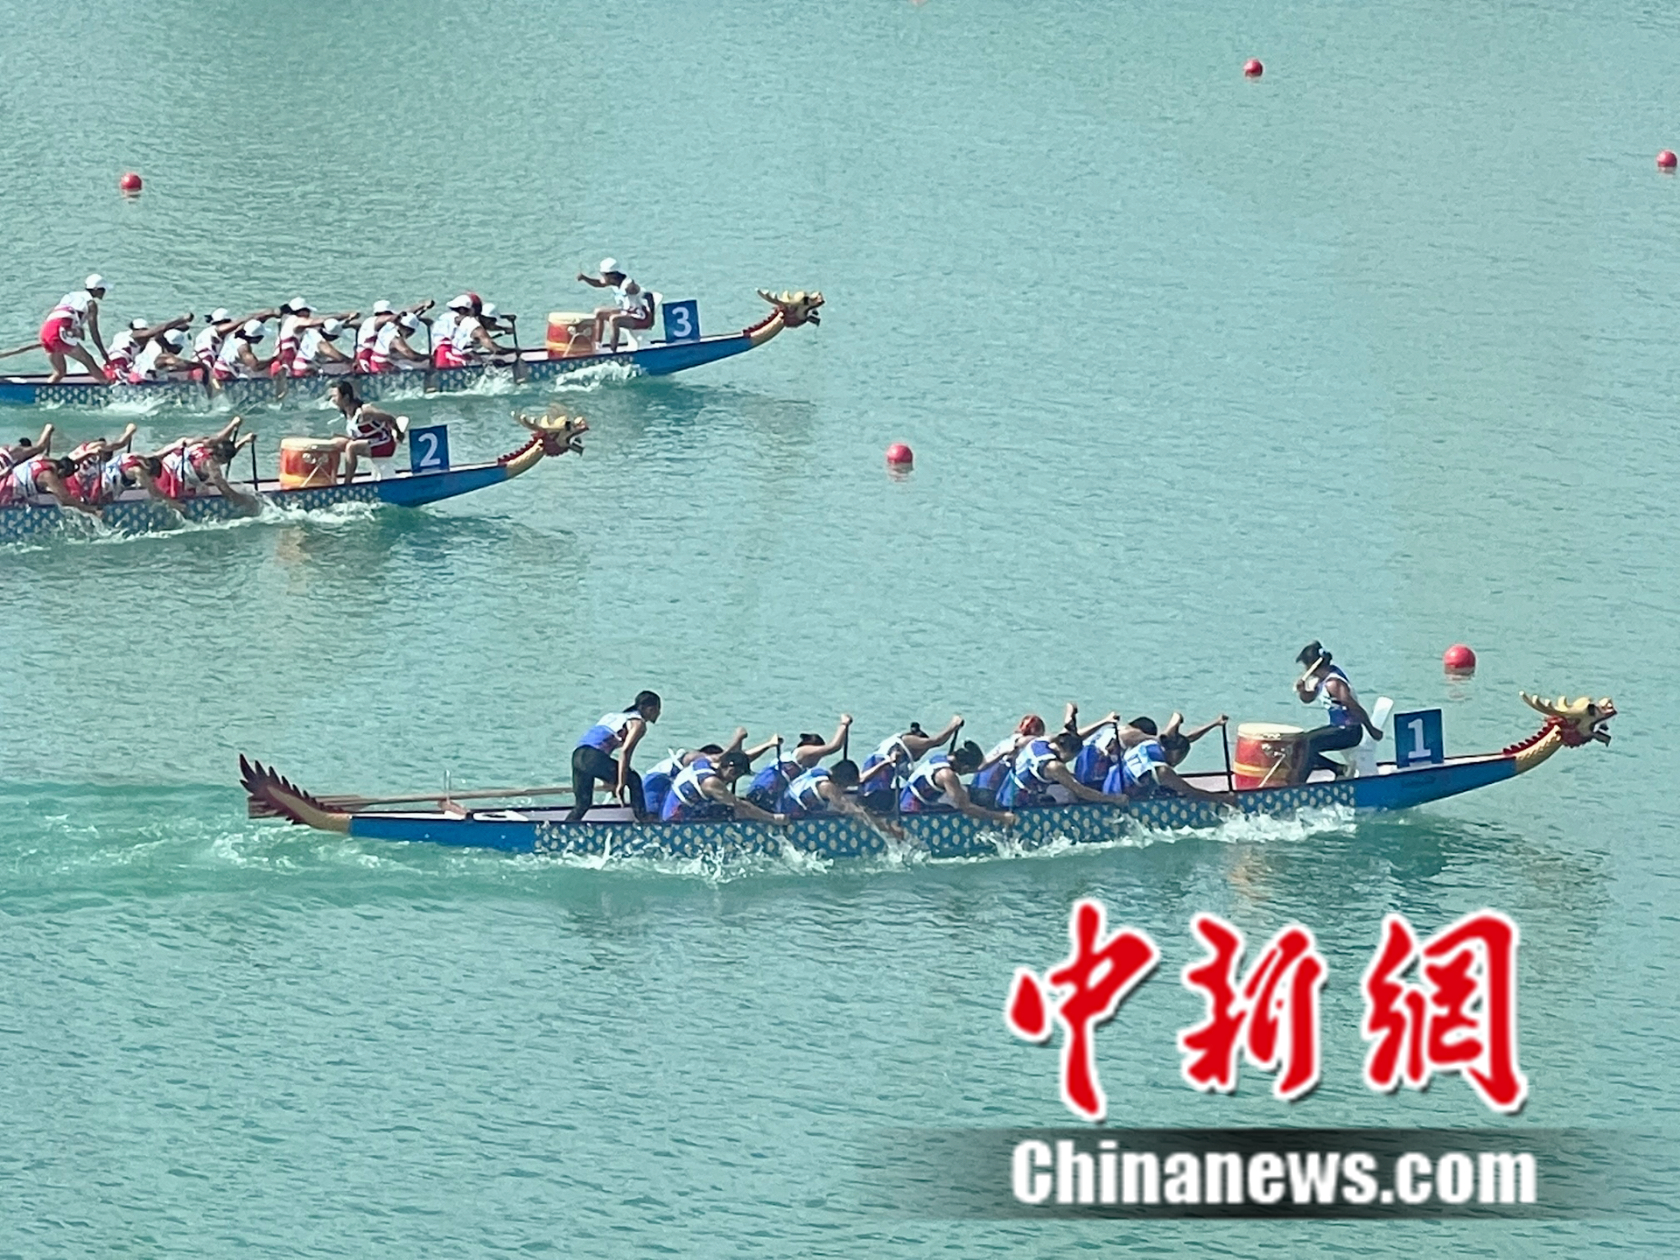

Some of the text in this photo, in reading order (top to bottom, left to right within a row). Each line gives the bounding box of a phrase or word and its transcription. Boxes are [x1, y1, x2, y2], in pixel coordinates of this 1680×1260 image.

[672, 305, 693, 339] 3
[417, 431, 442, 468] 2
[1406, 717, 1432, 759] 1
